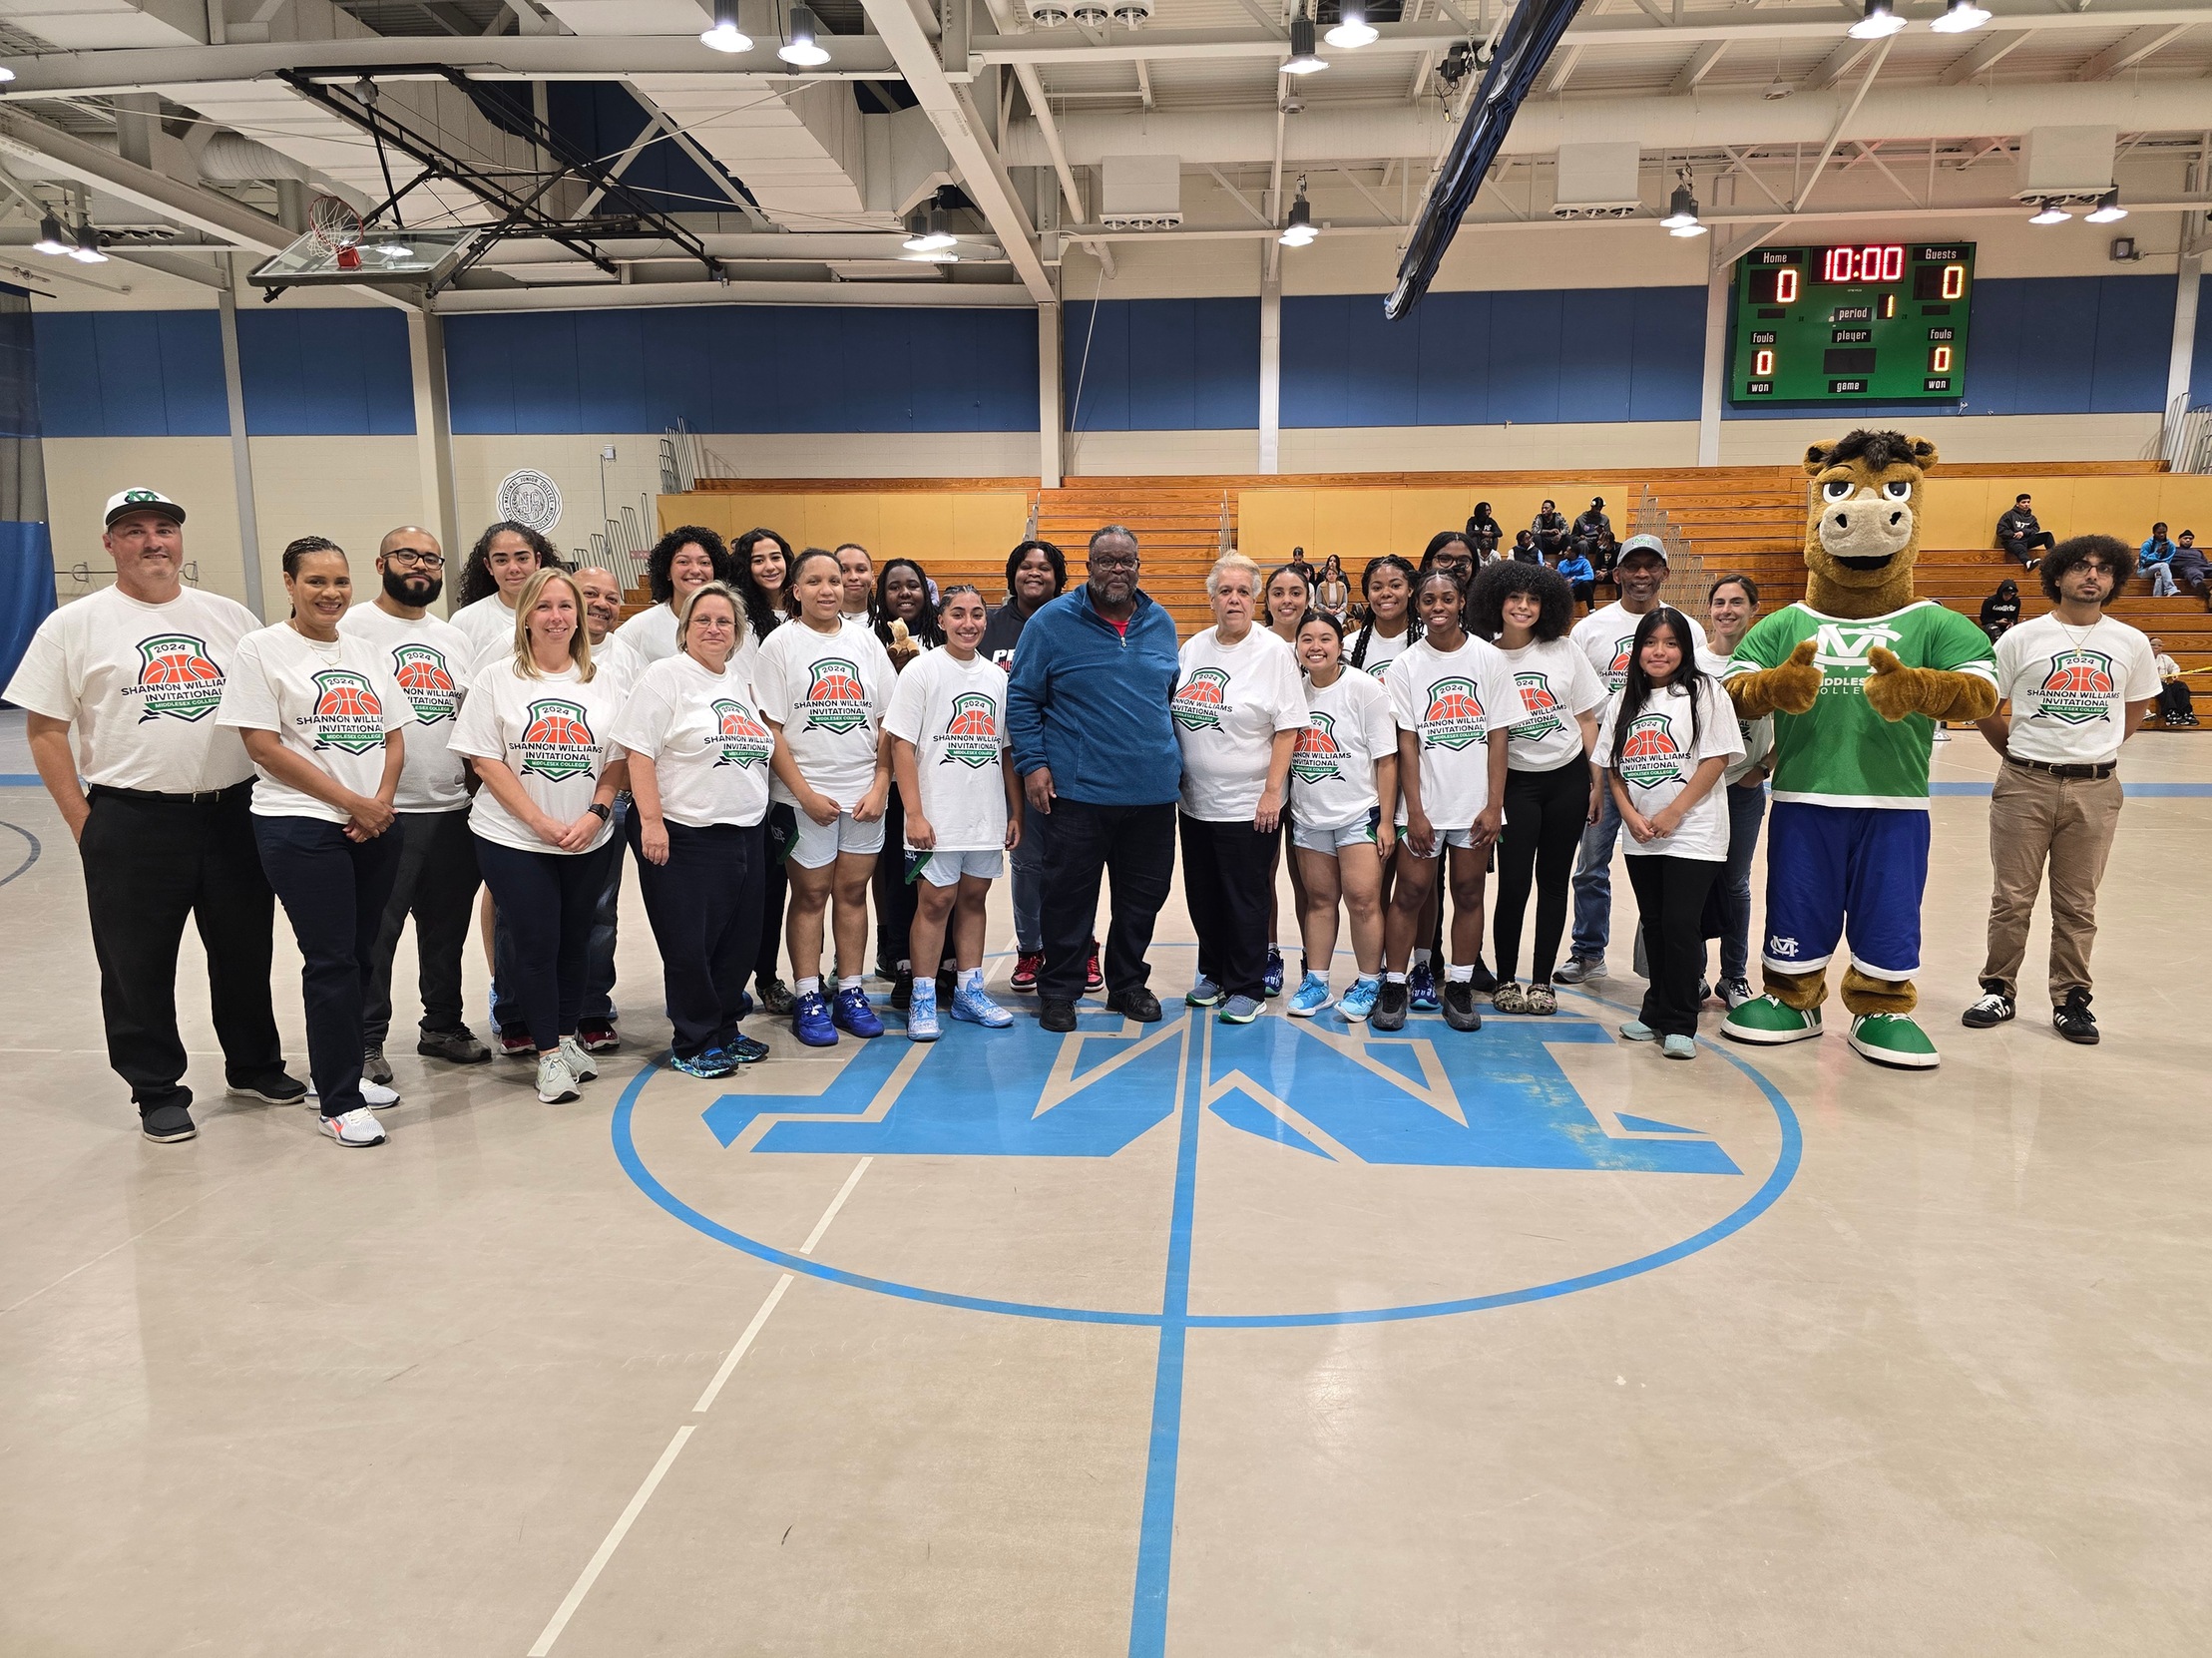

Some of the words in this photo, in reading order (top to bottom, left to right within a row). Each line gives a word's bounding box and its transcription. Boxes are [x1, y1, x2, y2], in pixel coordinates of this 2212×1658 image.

[1763, 252, 1787, 264] Home
[1925, 248, 1957, 260] Guests
[1824, 246, 1904, 281] 10:00
[1776, 269, 1797, 302] 0
[1943, 265, 1964, 299] 0
[1886, 295, 1894, 317] 1
[1839, 307, 1868, 320] period
[1752, 332, 1774, 344] fouls
[1837, 330, 1867, 342] player
[1931, 328, 1953, 340] fouls
[1756, 350, 1773, 375] 0
[1934, 347, 1951, 372] 0
[1751, 383, 1769, 393] won
[1836, 381, 1860, 392] game
[1928, 379, 1946, 390] won
[154, 643, 187, 653] 2024
[406, 651, 431, 660] 2024
[121, 683, 184, 696] SHANNON
[184, 678, 226, 690] WILLIA
[1821, 677, 1865, 686] DDLES
[1439, 684, 1464, 694] 2024
[1820, 686, 1861, 695] OLLE
[2026, 689, 2076, 698] SHANNON
[146, 688, 222, 702] INVITATIONAL
[408, 696, 454, 705] ITATIONAL
[793, 700, 838, 709] SHANNON
[1172, 697, 1195, 706] NNON
[1196, 700, 1233, 712] WILLIAMS
[2042, 697, 2109, 707] INVITATIONAL
[542, 706, 570, 715] 2024
[295, 715, 350, 725] SHANNON
[351, 715, 383, 724] WILLI
[1417, 718, 1455, 730] HANNON
[1427, 724, 1485, 735] INVITATIONAL
[703, 735, 746, 744] SHANNON
[976, 735, 1002, 744] WILLIAS
[509, 742, 556, 751] SHANNON
[525, 751, 591, 761] INVITATIONAL
[1648, 752, 1691, 761] WILLIAMS
[1623, 761, 1678, 771] INVITATIONAL
